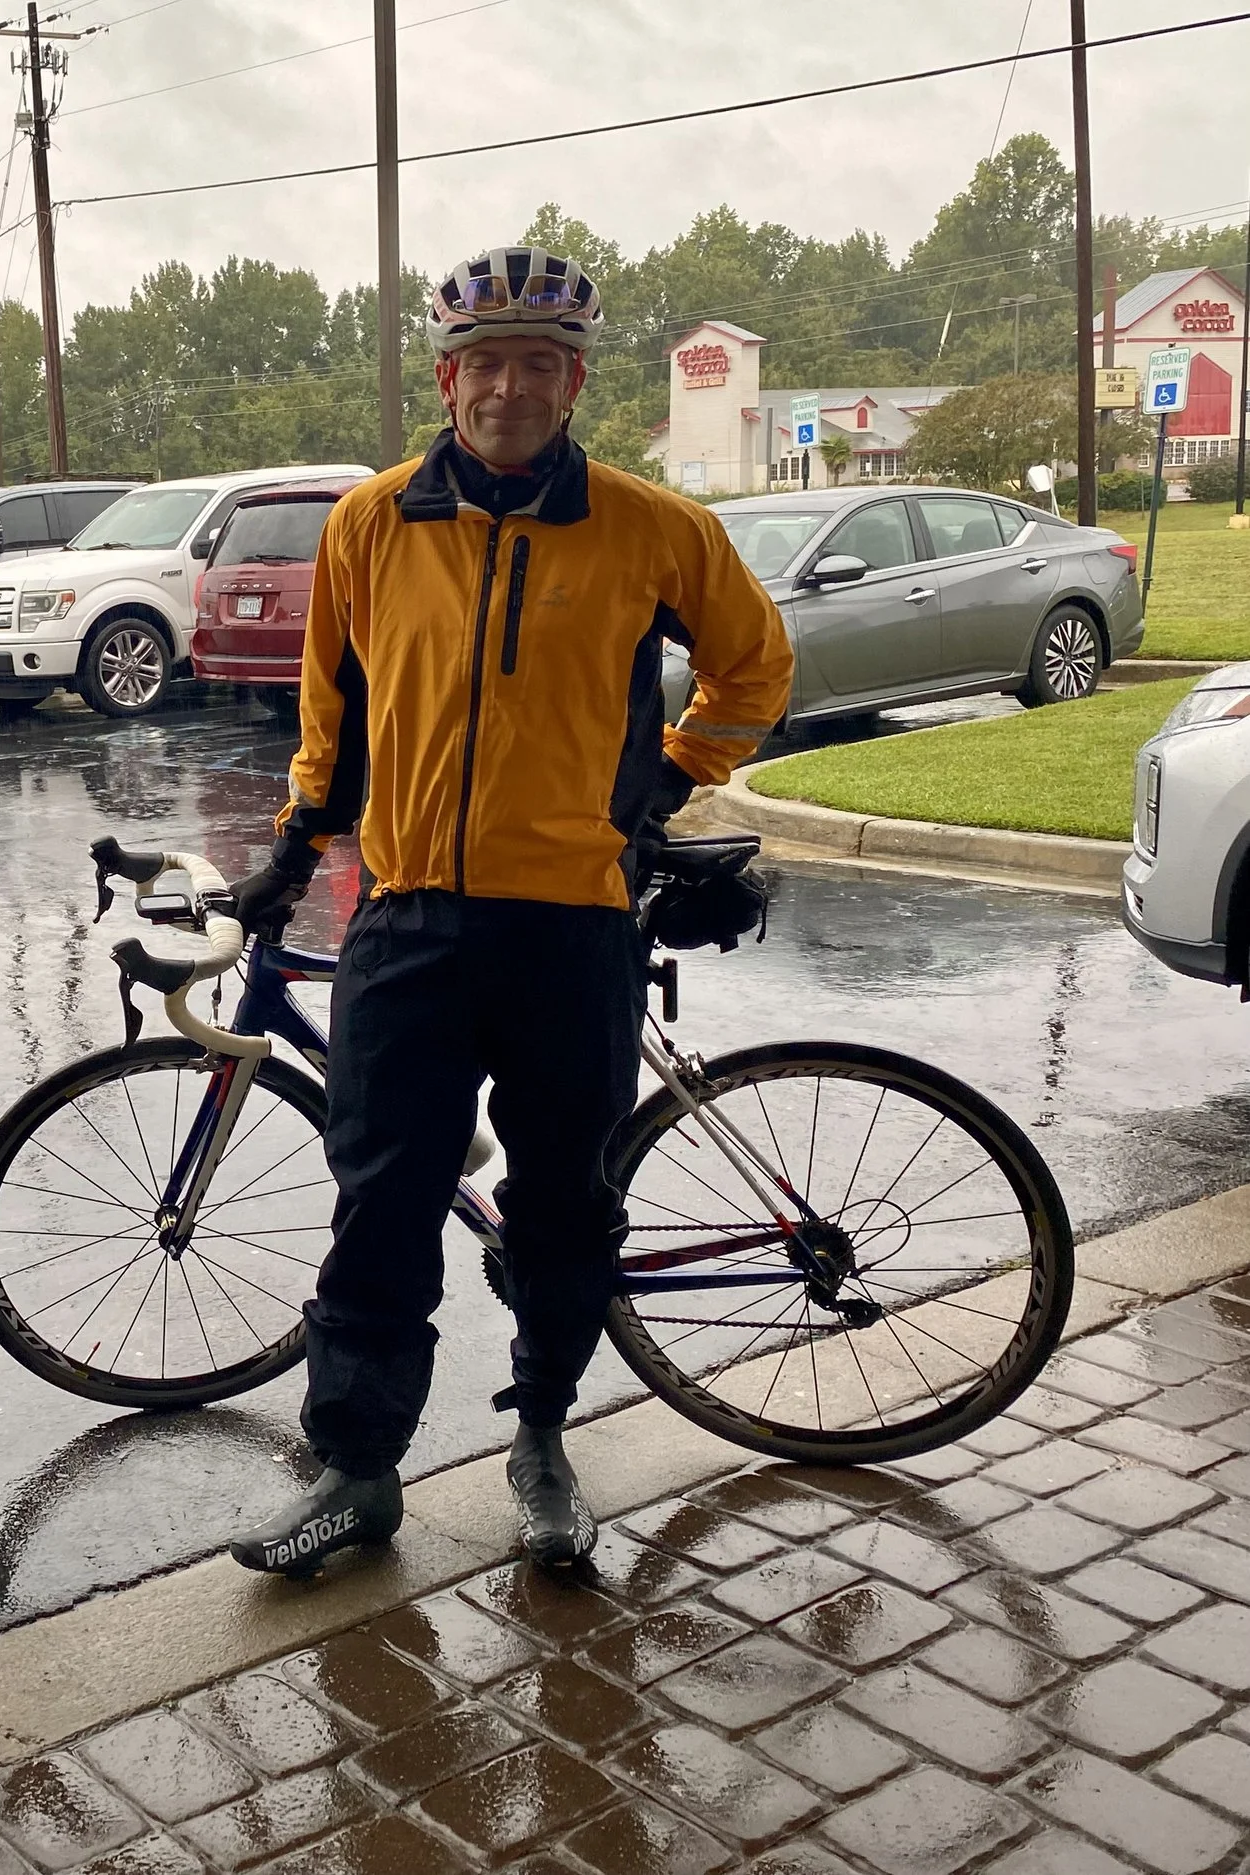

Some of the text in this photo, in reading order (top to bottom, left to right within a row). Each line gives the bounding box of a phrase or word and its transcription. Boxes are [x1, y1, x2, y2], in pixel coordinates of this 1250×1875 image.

[1174, 300, 1229, 321] golden
[1181, 315, 1235, 332] corral
[677, 344, 724, 367] golden
[1151, 353, 1187, 365] RESERVED
[685, 356, 730, 376] corral
[1153, 368, 1183, 380] PARKING
[792, 399, 818, 410] RESERVED
[795, 411, 816, 421] PARKING
